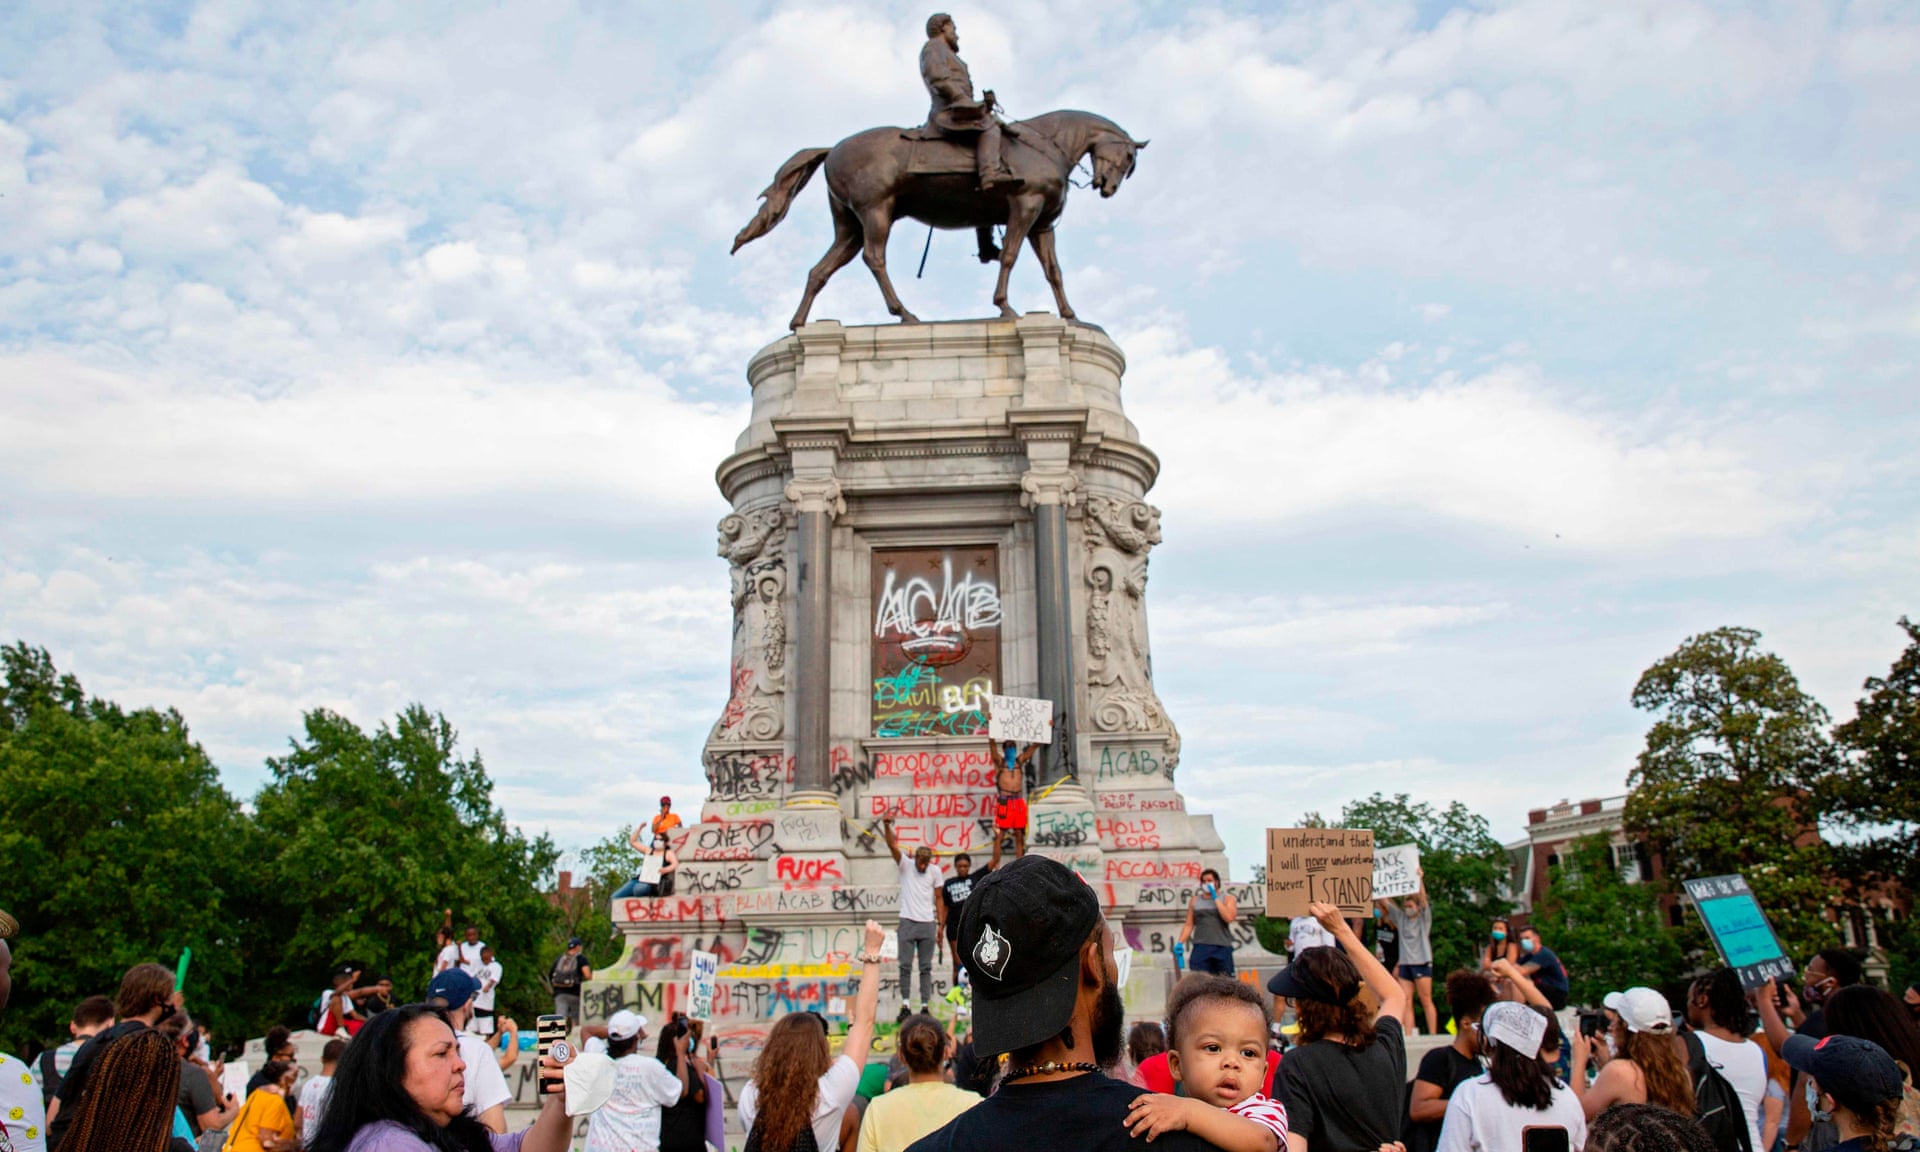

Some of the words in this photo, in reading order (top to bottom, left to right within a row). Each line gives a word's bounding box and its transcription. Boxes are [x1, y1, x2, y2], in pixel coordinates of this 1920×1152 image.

[875, 558, 1005, 638] ACAB
[875, 752, 930, 779] BLOOD
[1098, 746, 1158, 781] ACAB
[913, 769, 996, 788] HANDS
[700, 826, 747, 850] ONE
[895, 821, 974, 850] FUCK
[1096, 819, 1156, 840] HOLD
[1271, 831, 1274, 849] I
[1283, 832, 1345, 849] understand
[1350, 833, 1371, 848] that
[1114, 835, 1161, 851] COPS
[777, 857, 842, 881] FUCK
[1269, 854, 1273, 873] I
[1281, 854, 1299, 871] will
[1305, 857, 1328, 868] never
[687, 868, 741, 894] ACAB
[1378, 867, 1408, 885] LIVES
[1139, 888, 1175, 904] END
[1306, 874, 1316, 903] I
[777, 893, 823, 911] ACAB
